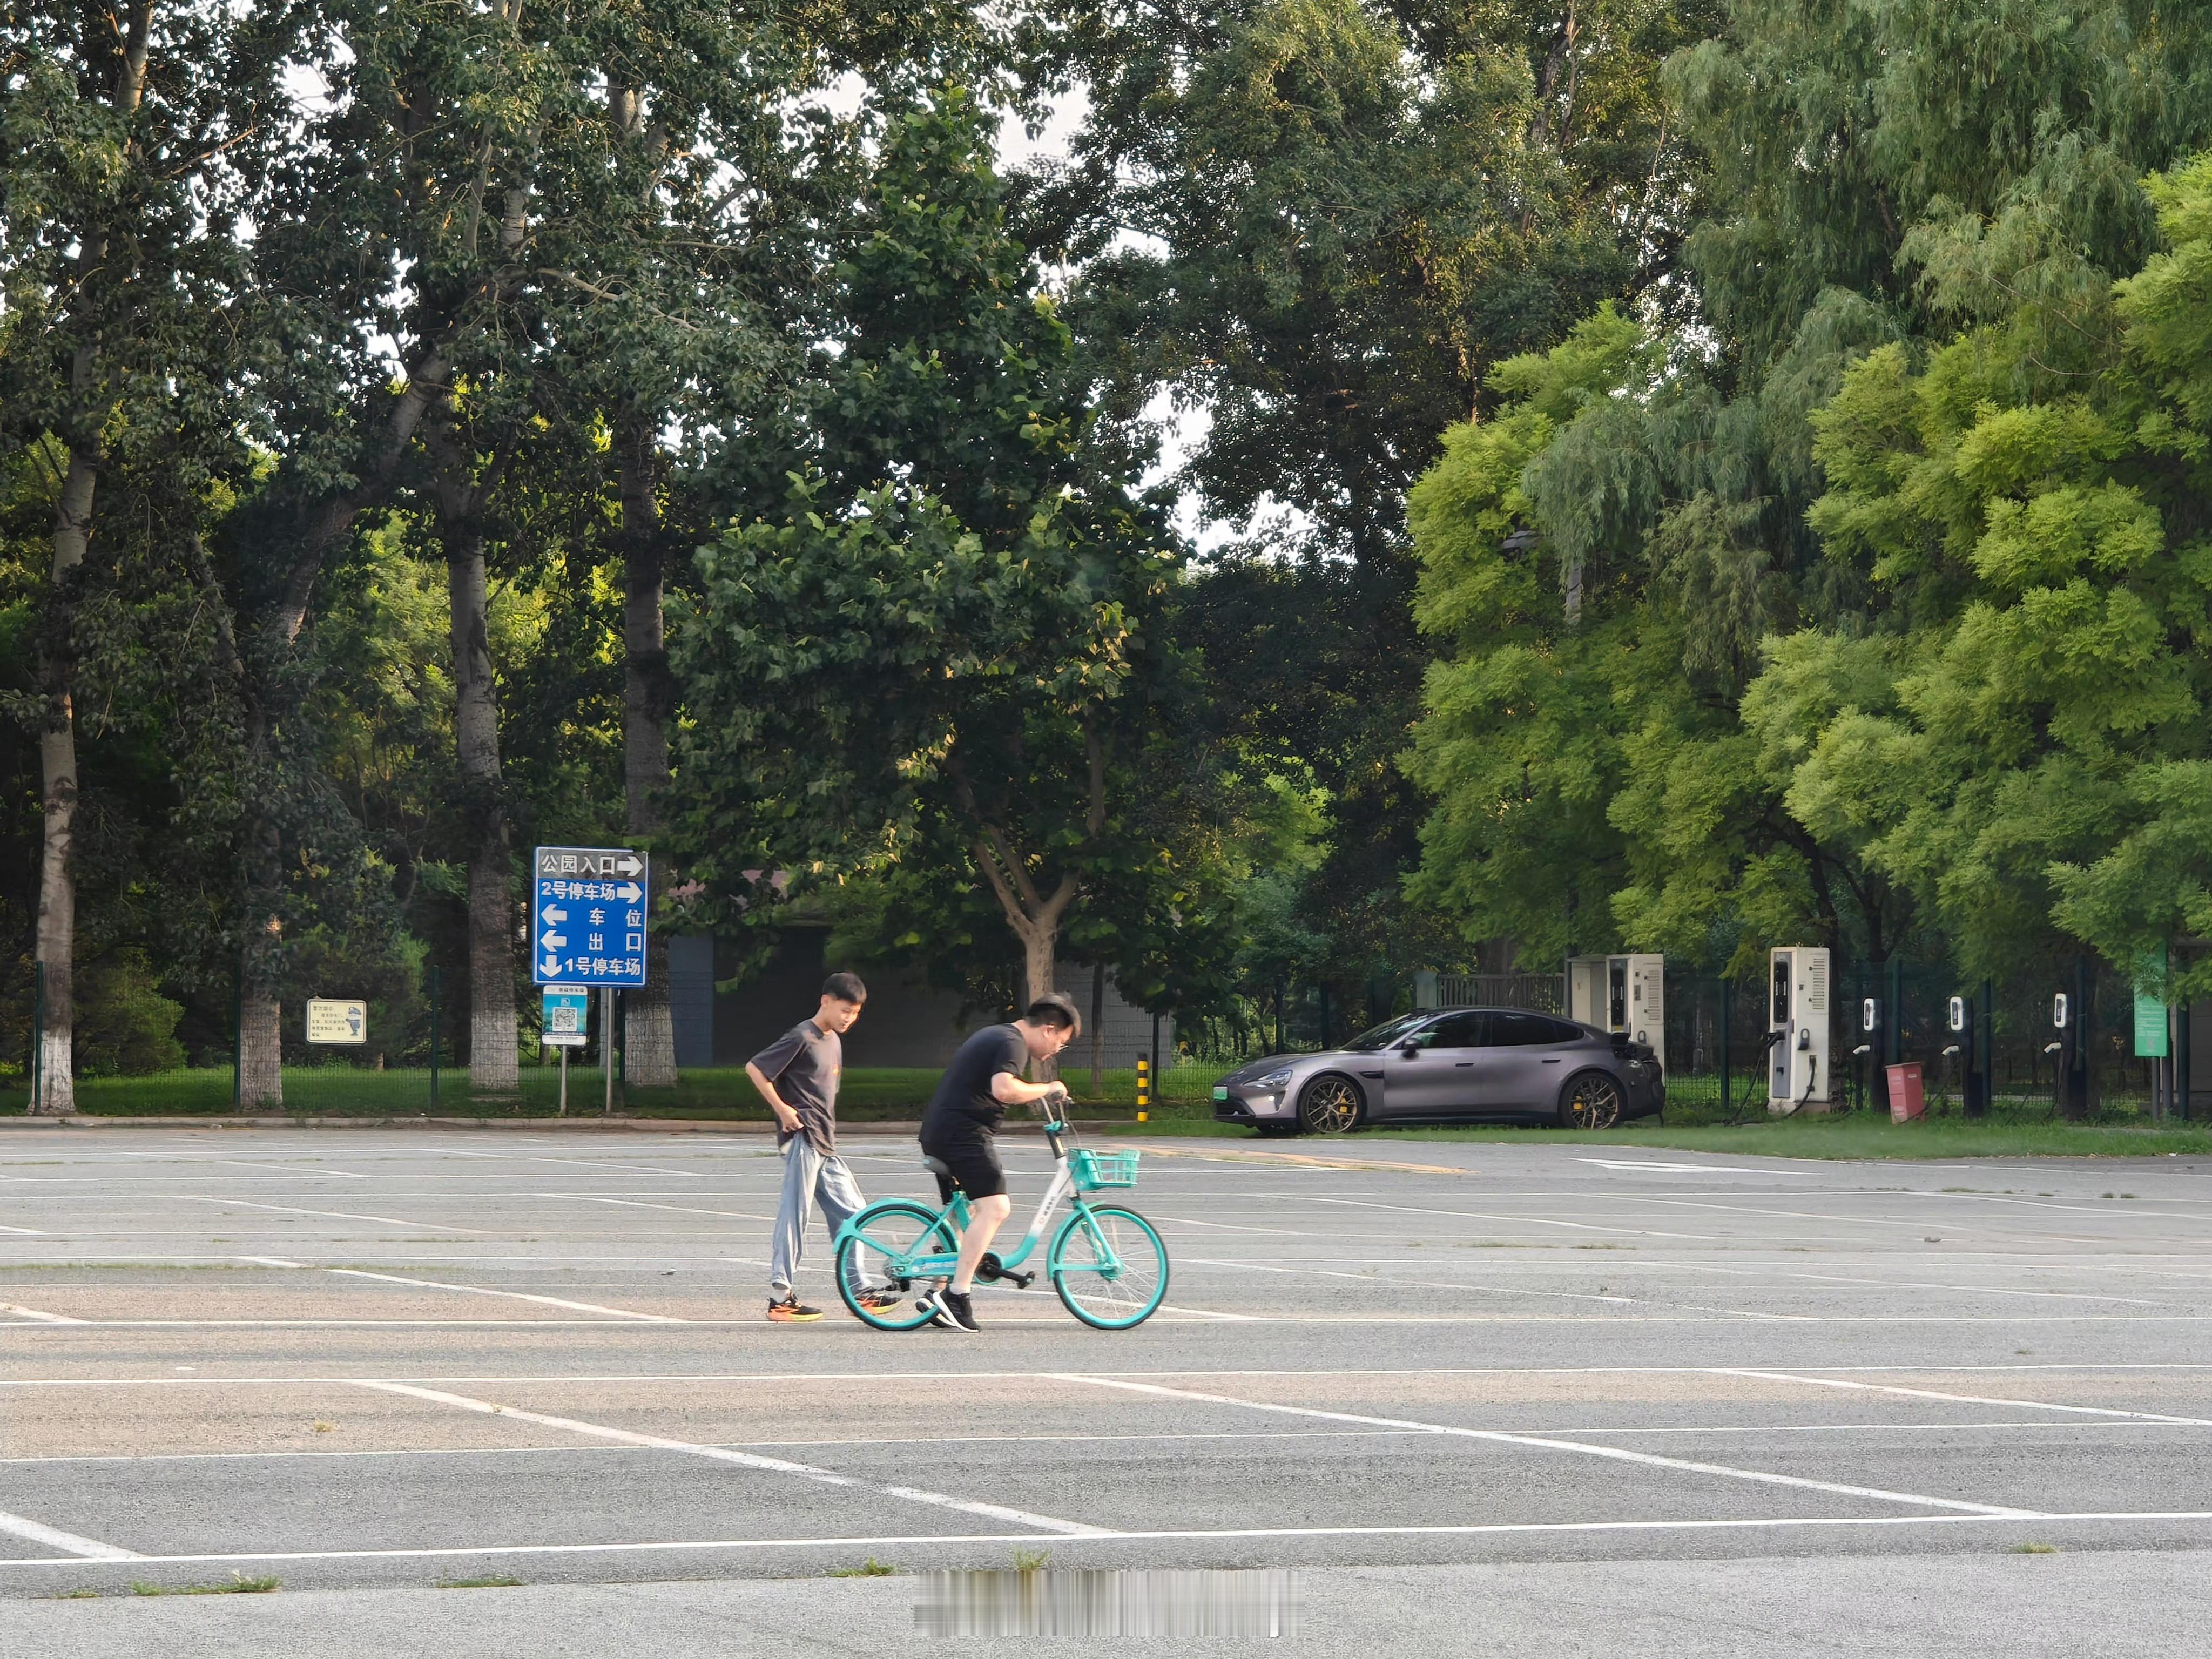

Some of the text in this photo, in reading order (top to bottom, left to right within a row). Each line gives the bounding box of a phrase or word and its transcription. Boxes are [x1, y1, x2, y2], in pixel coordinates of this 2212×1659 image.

[541, 855, 615, 874] 公园入口
[541, 881, 615, 901] 2号停车场
[565, 957, 641, 976] 1号停车场
